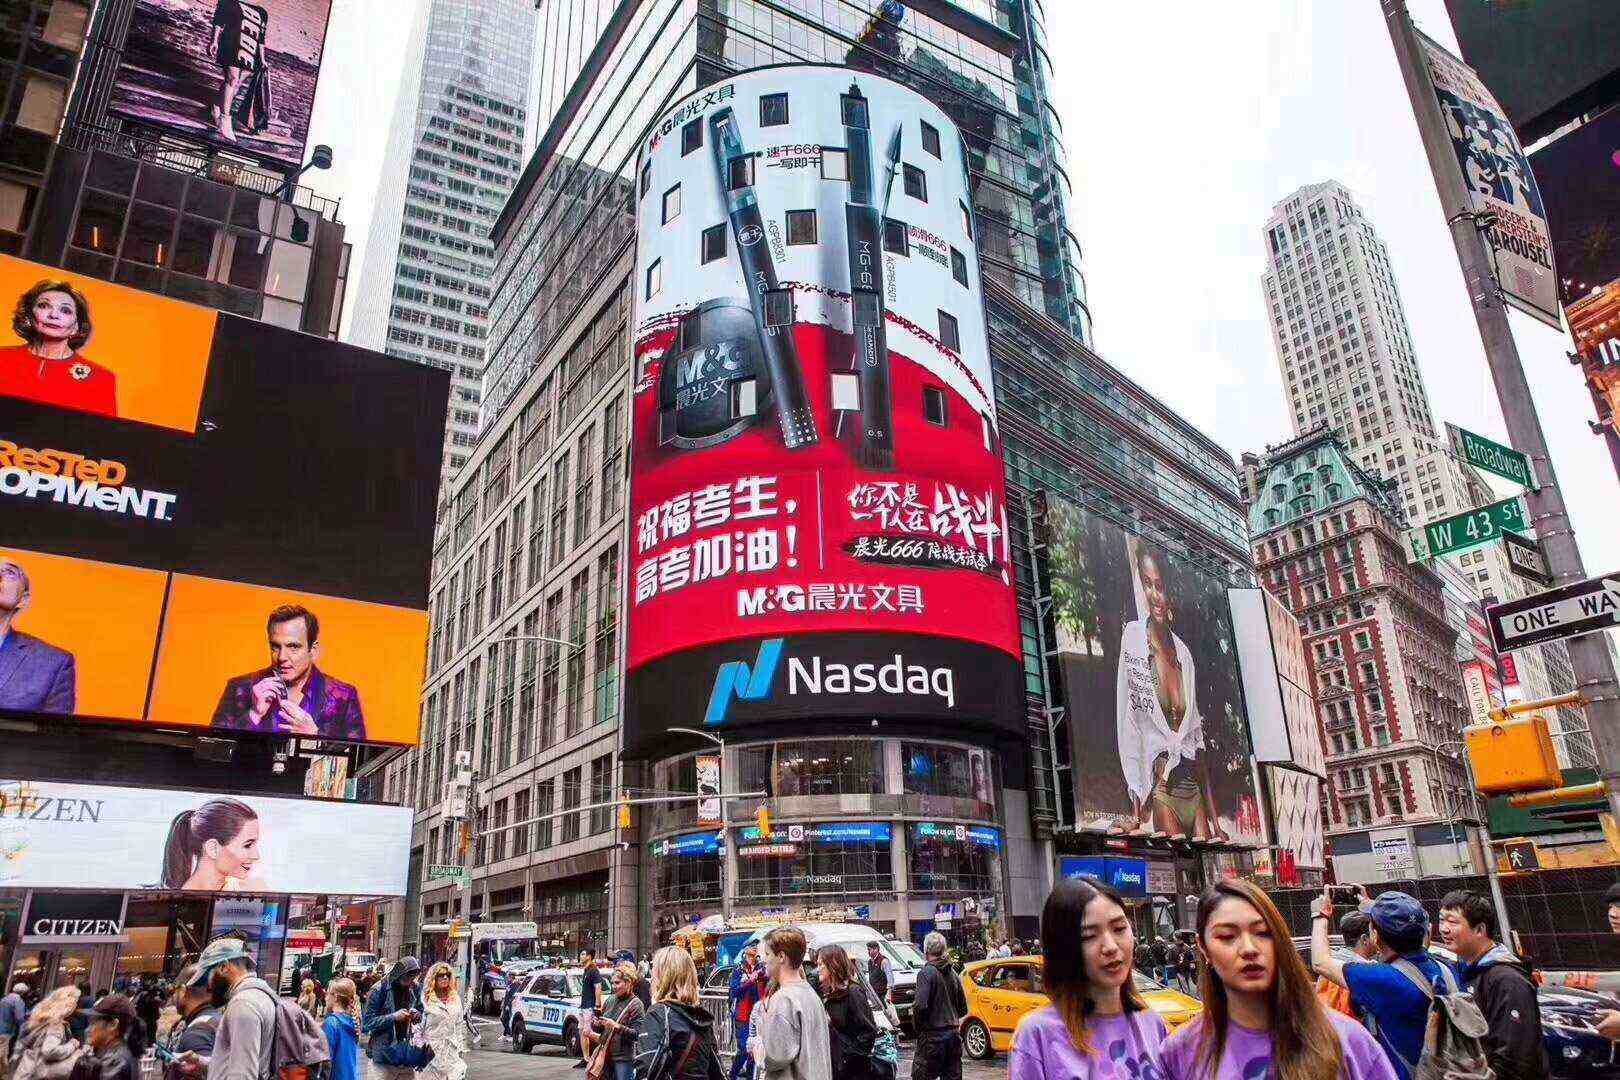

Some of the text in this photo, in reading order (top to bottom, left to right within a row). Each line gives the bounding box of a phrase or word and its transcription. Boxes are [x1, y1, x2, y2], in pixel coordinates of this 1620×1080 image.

[1488, 228, 1551, 270] AROUSEL
[1467, 436, 1526, 480] Broadway
[847, 481, 929, 509] 你不是
[852, 504, 930, 533] 一个人在
[1431, 503, 1522, 549] W 43 St
[853, 536, 924, 560] 晨光666
[1513, 546, 1537, 570] ONE
[737, 582, 925, 617] M&G 晨光文具
[1513, 605, 1560, 634] ONE
[788, 654, 955, 708] Nasdaq
[806, 873, 841, 885] Nasdaq
[33, 918, 123, 936] CITIZEN
